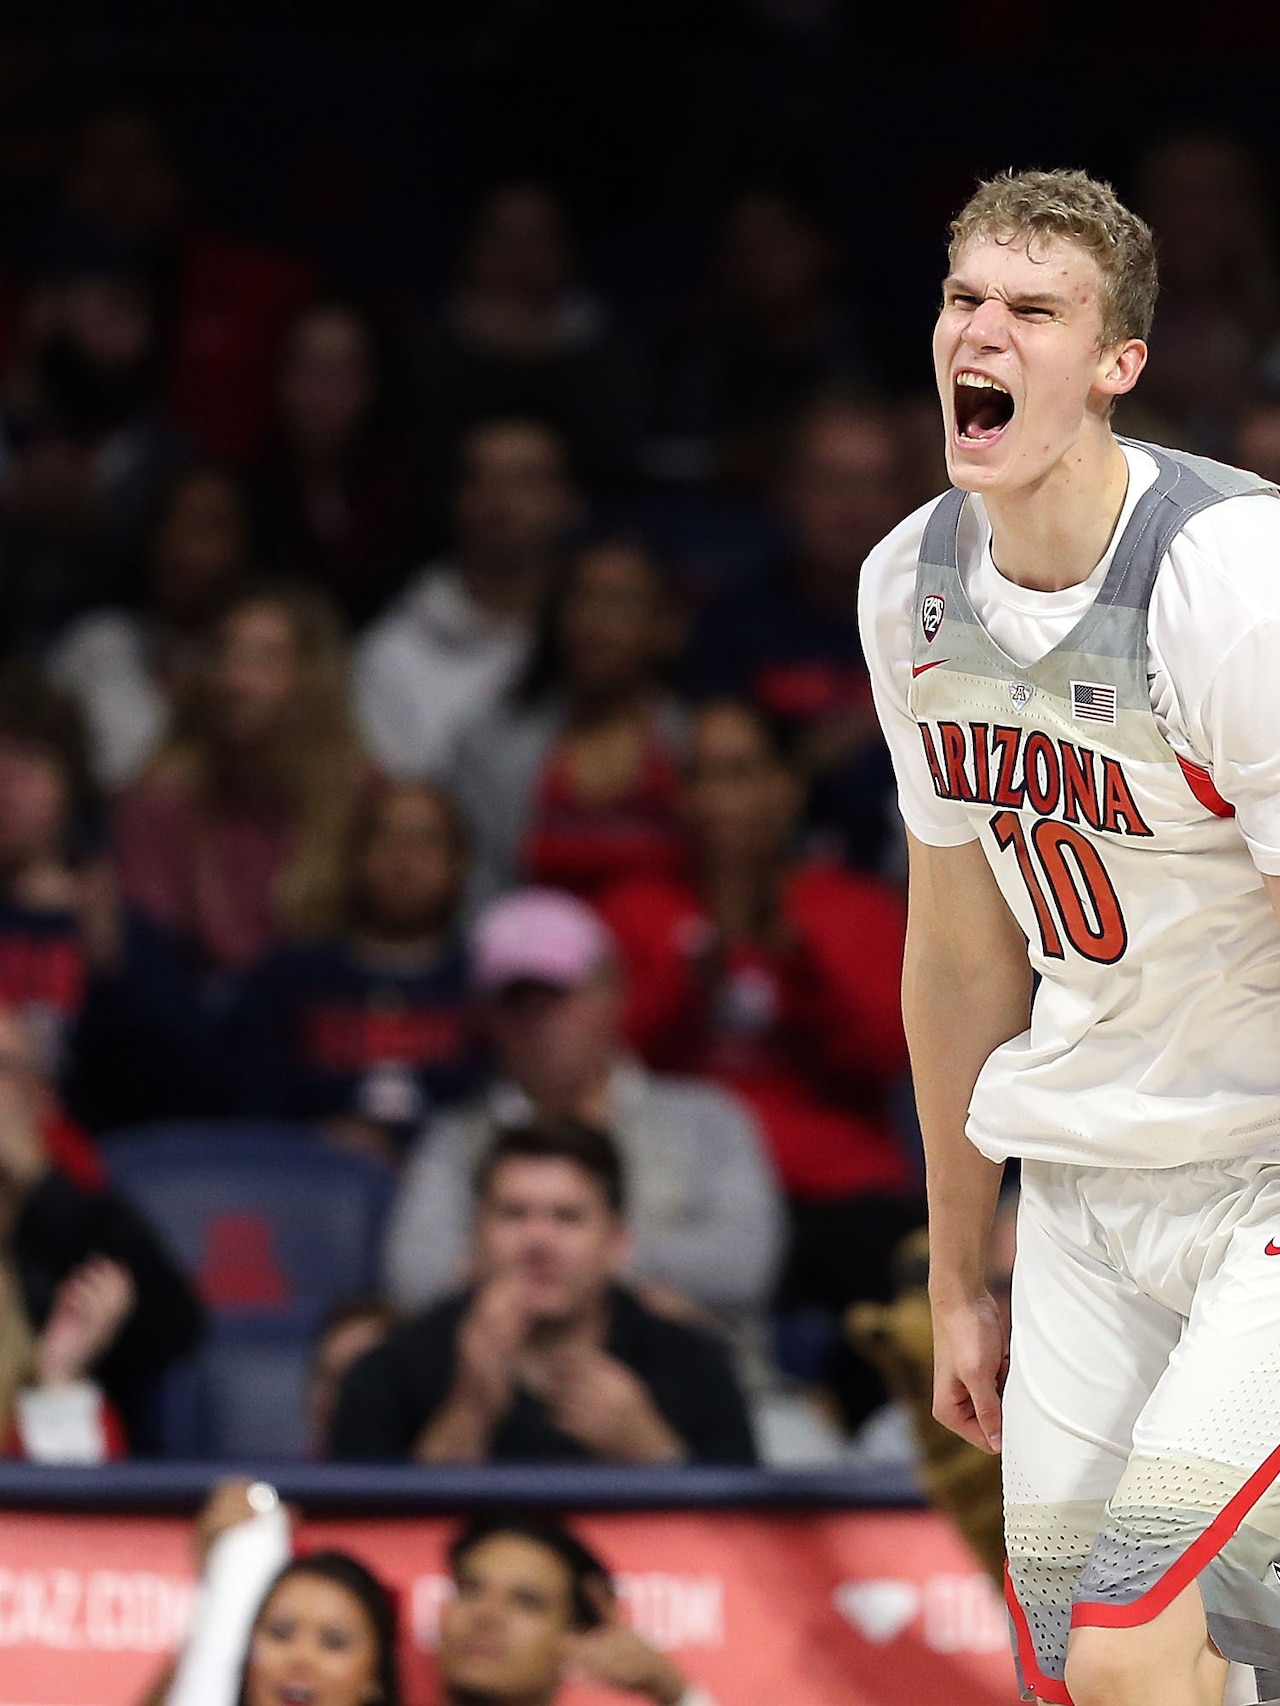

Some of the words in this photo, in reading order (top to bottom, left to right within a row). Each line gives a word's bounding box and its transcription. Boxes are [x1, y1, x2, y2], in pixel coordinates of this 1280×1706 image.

[925, 615, 937, 632] 12
[917, 721, 1154, 837] ARIZONA
[989, 810, 1128, 965] 10
